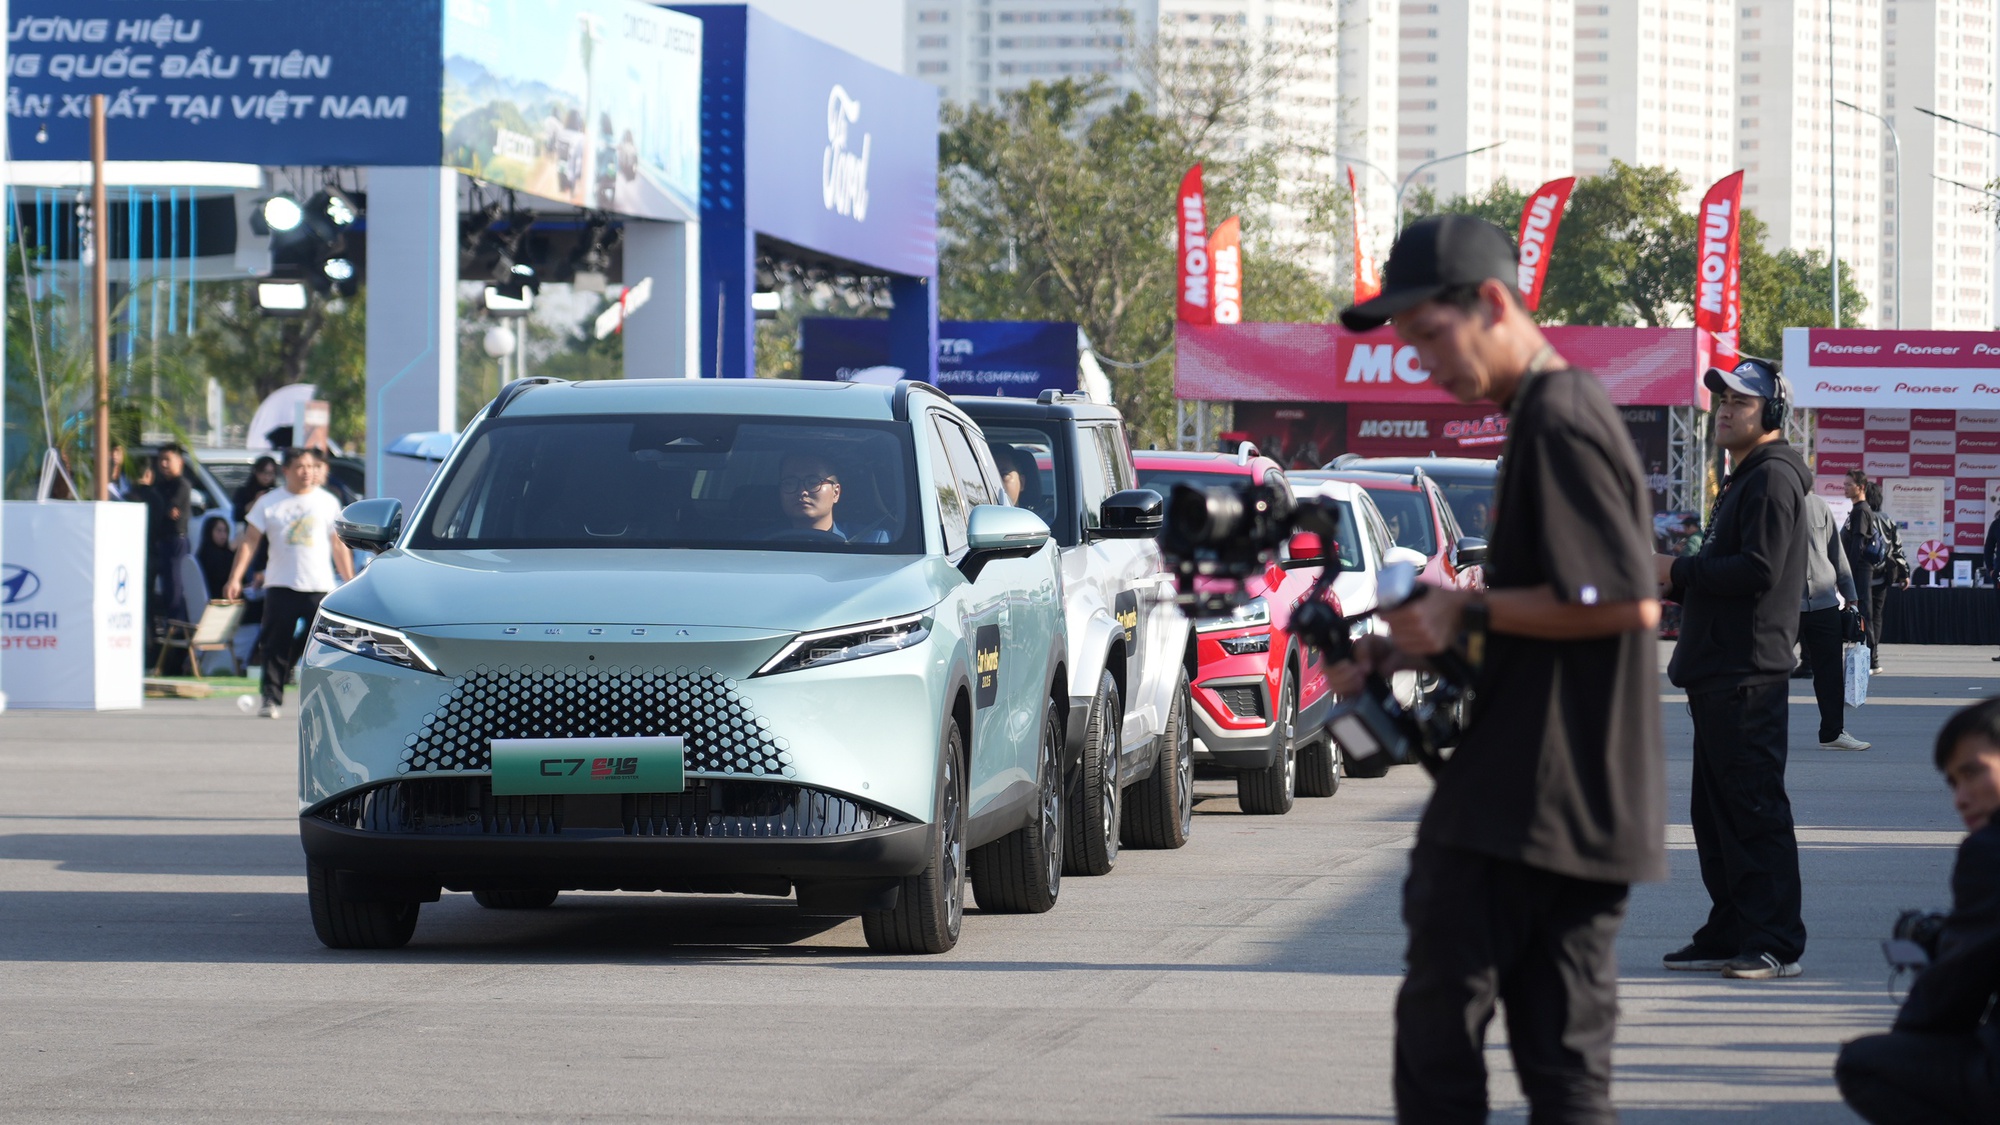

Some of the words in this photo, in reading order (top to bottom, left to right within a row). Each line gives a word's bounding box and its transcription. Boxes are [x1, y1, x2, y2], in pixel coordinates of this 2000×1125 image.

[116, 14, 203, 48] HIỆU
[49, 46, 154, 81] QUỐC
[160, 46, 240, 78] ĐẦU
[248, 49, 331, 79] TIÊN
[165, 94, 222, 125] TẠI
[231, 90, 314, 125] VIỆT
[319, 95, 408, 119] NAM
[822, 83, 872, 222] Ford
[1517, 193, 1559, 295] MOTUL
[1183, 193, 1209, 308] MOTUL
[1700, 198, 1732, 314] MOTUL
[1214, 245, 1240, 323] OTUL
[1814, 341, 1882, 354] Pioneer
[1893, 343, 1960, 355] Pioneer
[975, 371, 1041, 384] COMPANY
[1815, 381, 1881, 393] Pioneer
[1894, 382, 1959, 393] Pioneer
[1822, 413, 1861, 422] Pioneer
[1868, 414, 1906, 423] Pioneer
[1913, 415, 1952, 424] Pioneer
[1959, 416, 1999, 424] Pioneer
[1358, 420, 1429, 438] MOTUL
[1821, 437, 1860, 445] Pioneer
[1867, 437, 1906, 446] Pioneer
[1913, 438, 1952, 446] Pioneer
[1959, 439, 1998, 447] Pioneer
[1821, 460, 1860, 468] Pioneer
[1912, 461, 1951, 470] Pioneer
[1958, 462, 1998, 470] Pioneer
[1892, 483, 1935, 492] Pioneer
[503, 627, 690, 637] OMODA
[540, 758, 585, 777] C7
